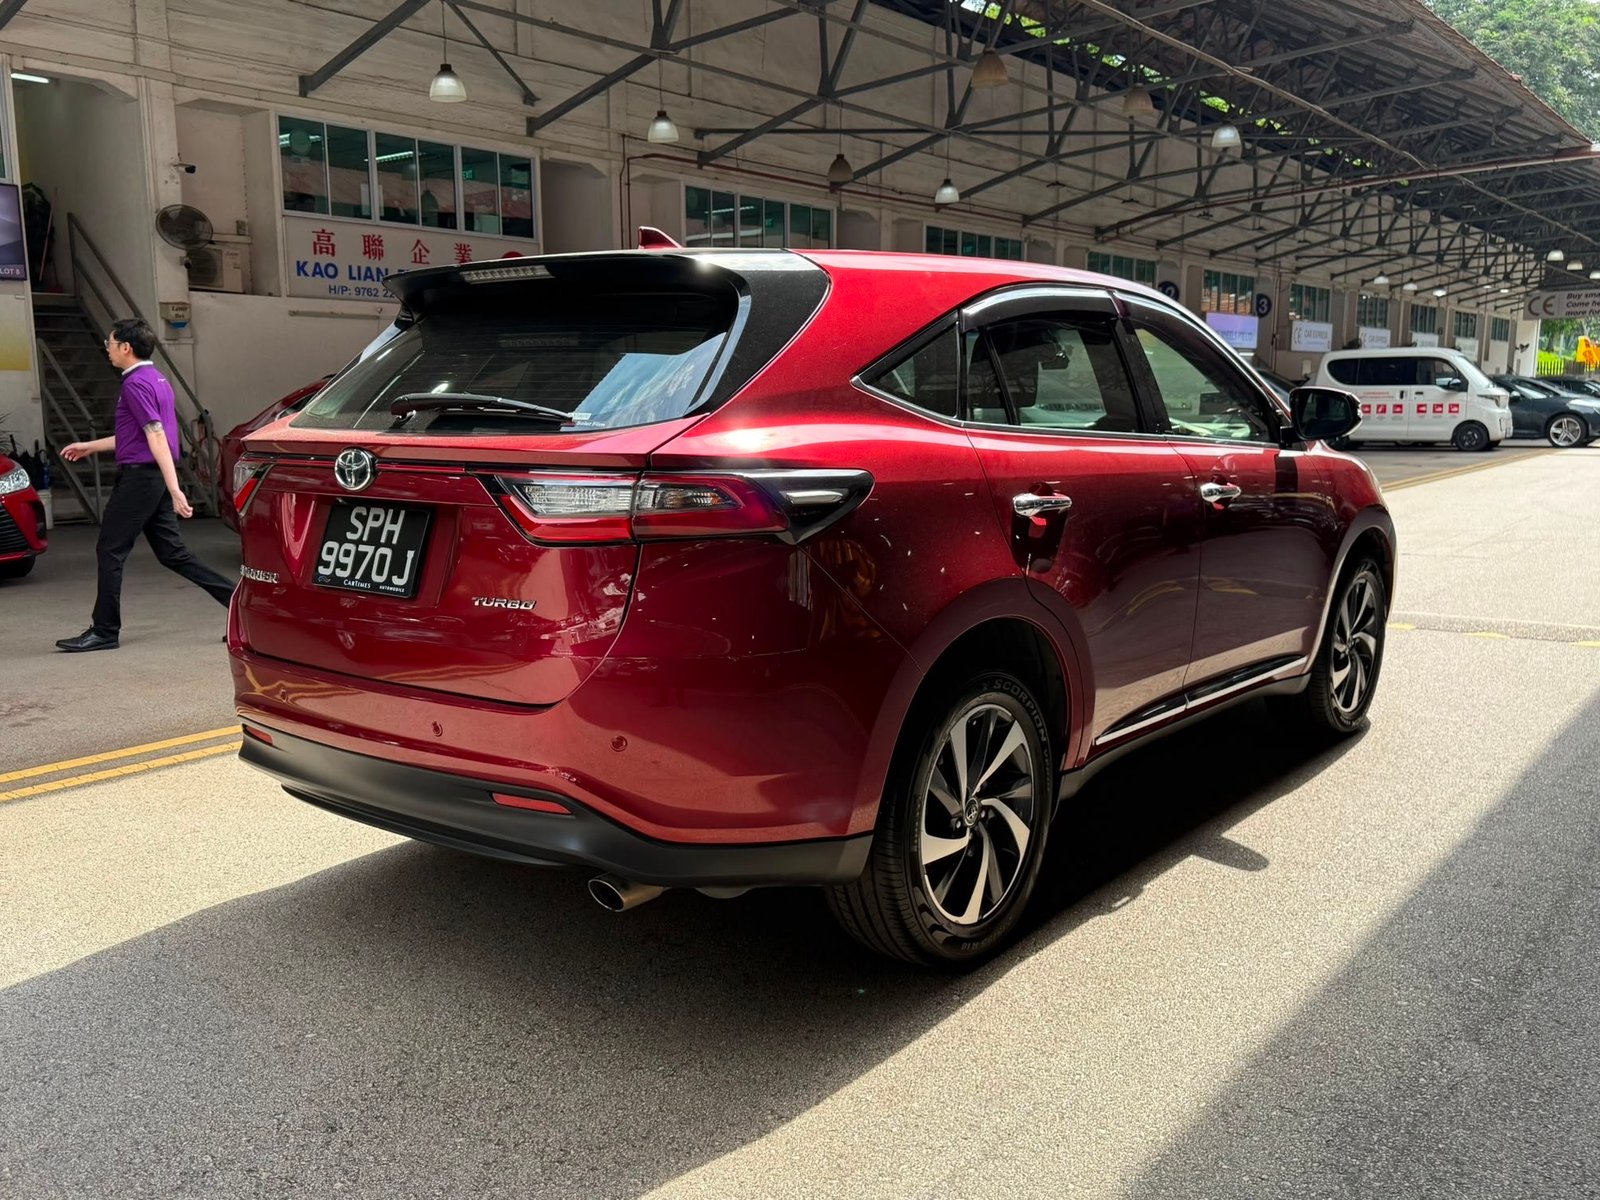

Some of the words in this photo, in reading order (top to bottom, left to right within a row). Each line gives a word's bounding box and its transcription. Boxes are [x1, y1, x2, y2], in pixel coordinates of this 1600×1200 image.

[296, 260, 339, 280] KAO
[328, 284, 352, 296] H/P:
[354, 286, 379, 298] 9762
[1566, 292, 1583, 300] Buy
[1528, 295, 1556, 316] CE
[346, 506, 406, 545] SPH
[317, 540, 416, 587] 9970J
[471, 596, 537, 610] TURBO
[993, 678, 1047, 743] SCORPION
